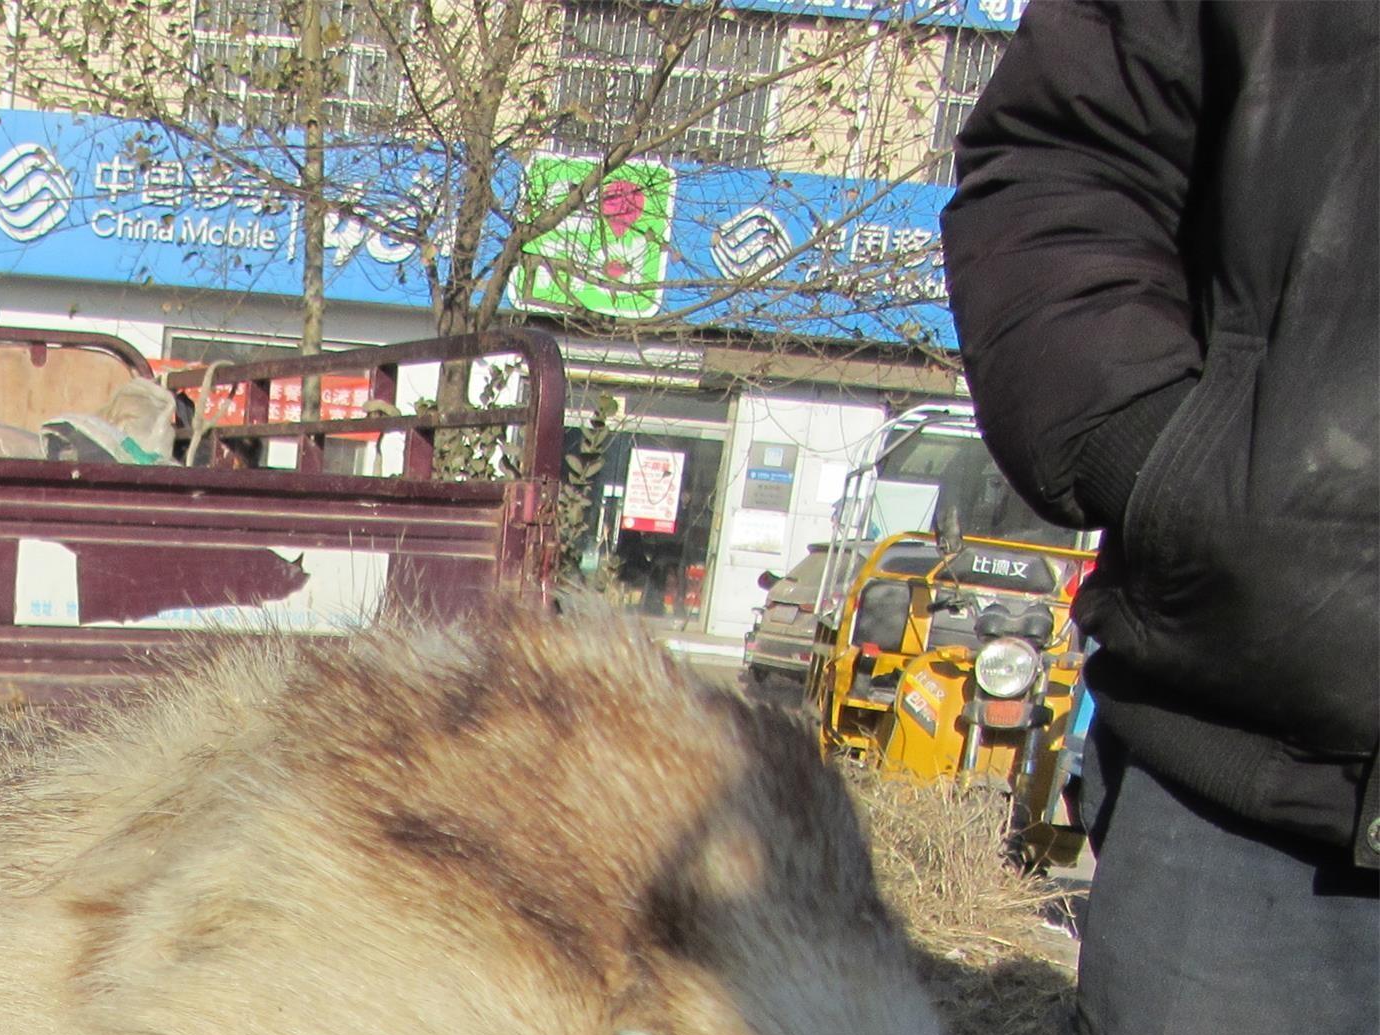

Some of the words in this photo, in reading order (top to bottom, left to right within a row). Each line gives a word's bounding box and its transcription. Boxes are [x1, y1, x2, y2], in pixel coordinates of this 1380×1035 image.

[94, 156, 285, 215] 中国移动
[91, 209, 174, 243] China
[182, 215, 276, 251] Mobile
[972, 555, 1029, 578] 比德文
